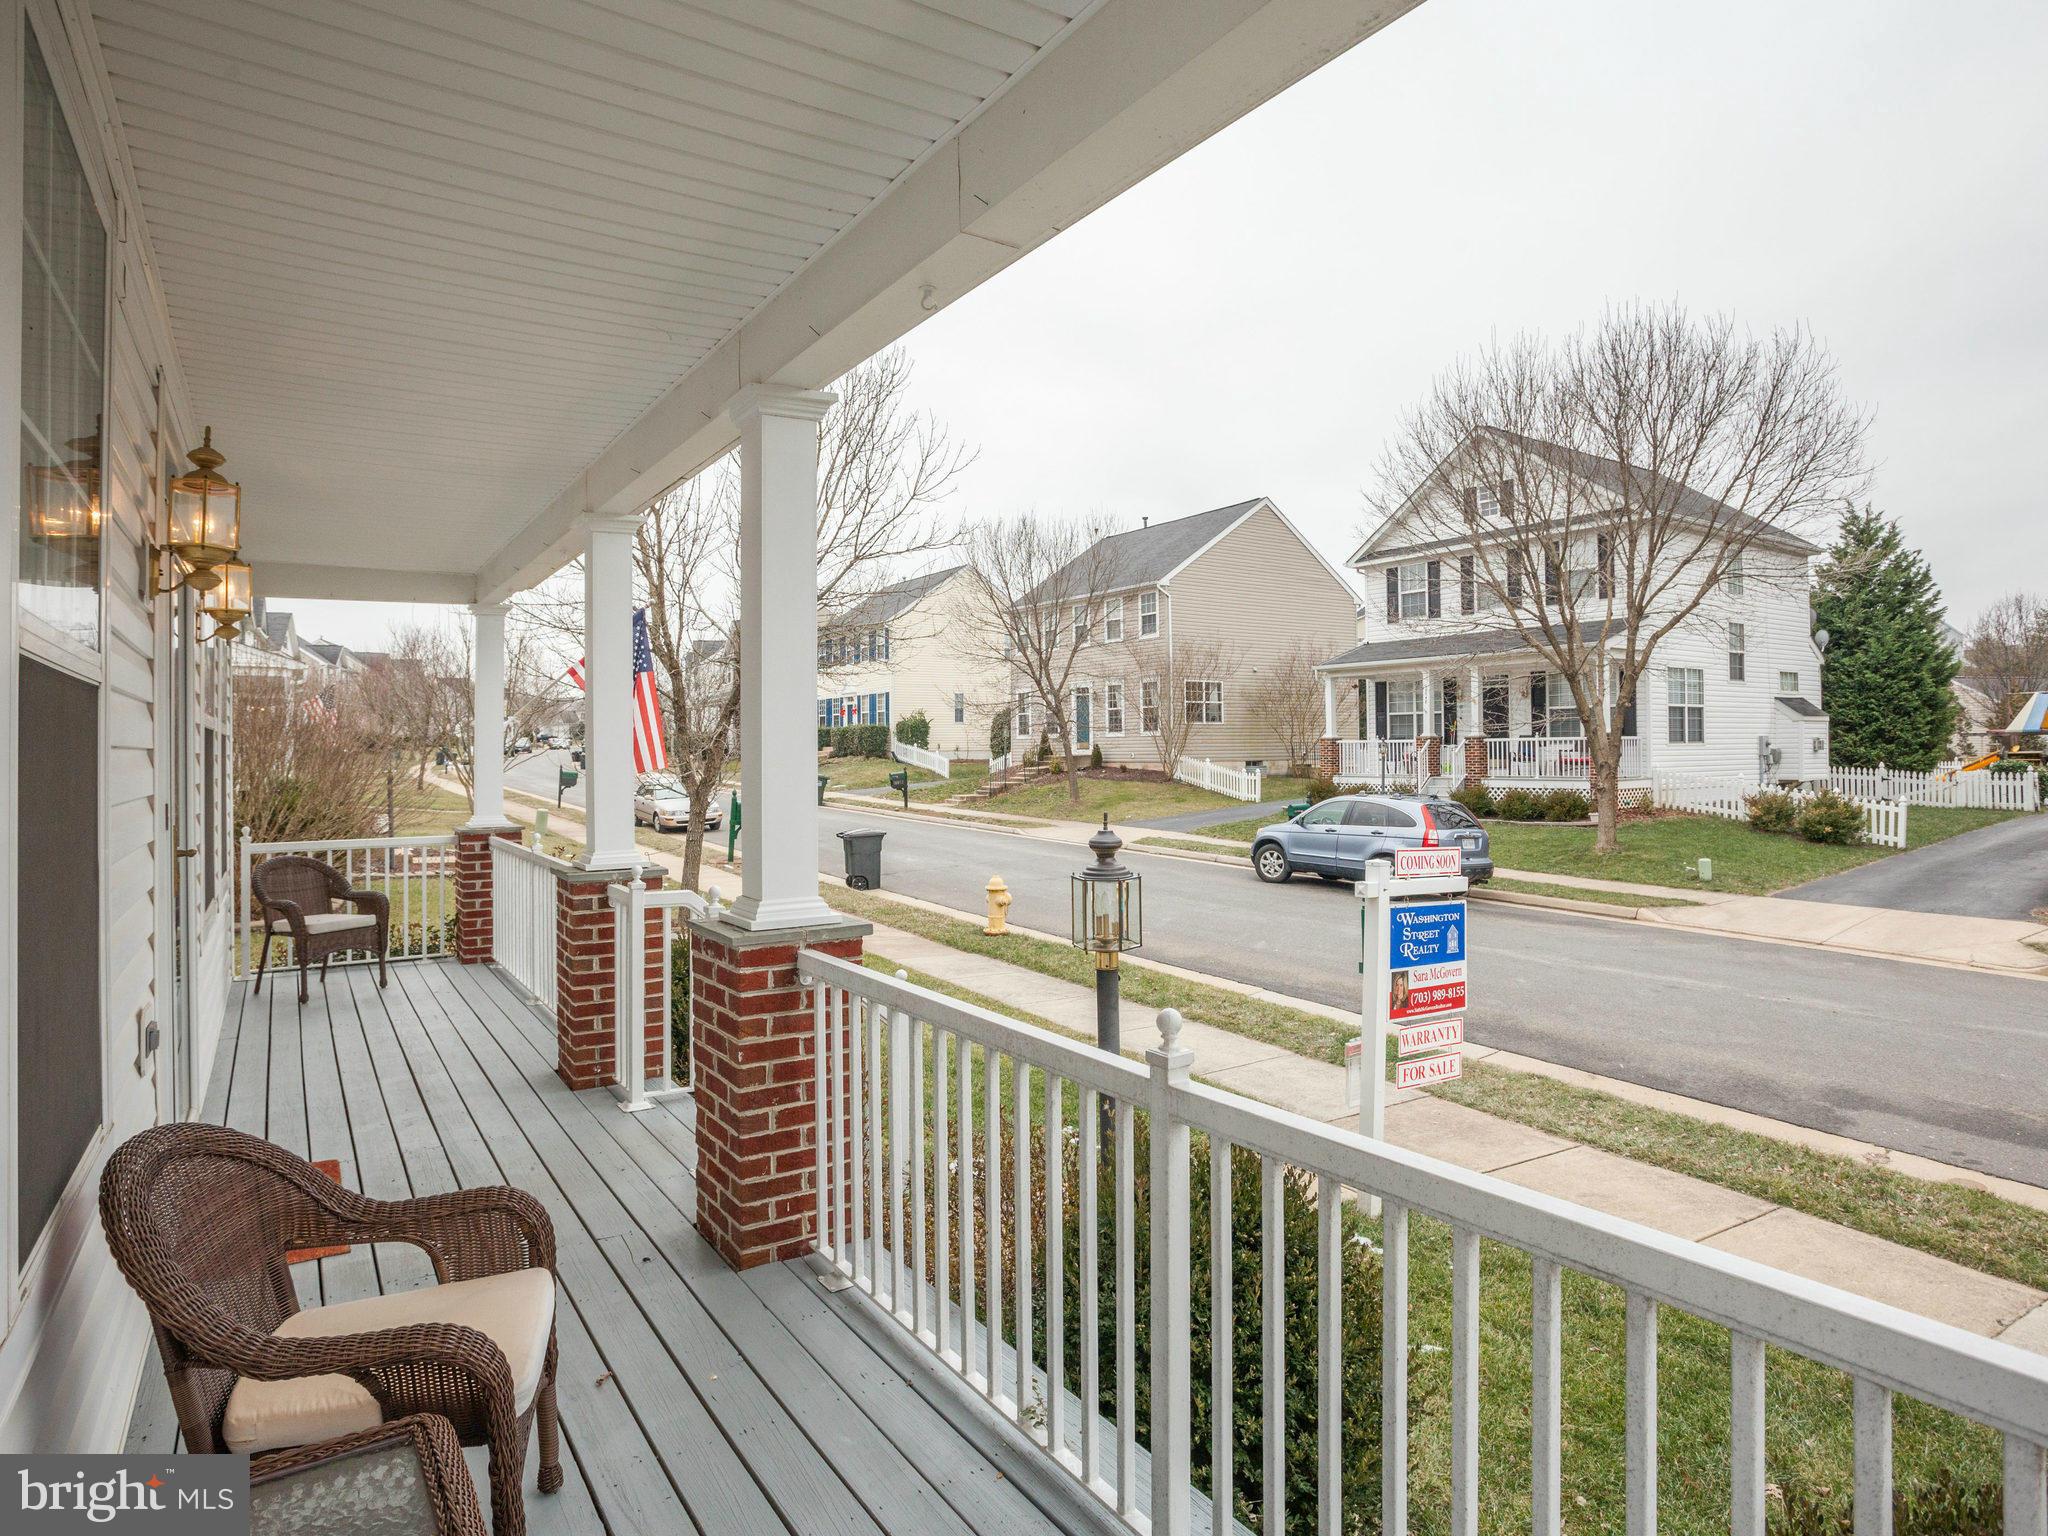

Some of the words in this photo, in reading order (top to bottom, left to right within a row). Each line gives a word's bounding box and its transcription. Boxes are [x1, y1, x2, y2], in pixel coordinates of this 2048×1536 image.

[1401, 856, 1434, 871] COMING
[1434, 855, 1456, 869] SOON
[1414, 970, 1429, 982] Sara
[1430, 967, 1463, 979] McGovern
[1411, 991, 1430, 1006] (703)
[1433, 986, 1465, 1001] 989-8155
[1402, 1026, 1458, 1048] WARRANTY
[1403, 1066, 1425, 1082] FOR
[1430, 1060, 1456, 1077] SALE
